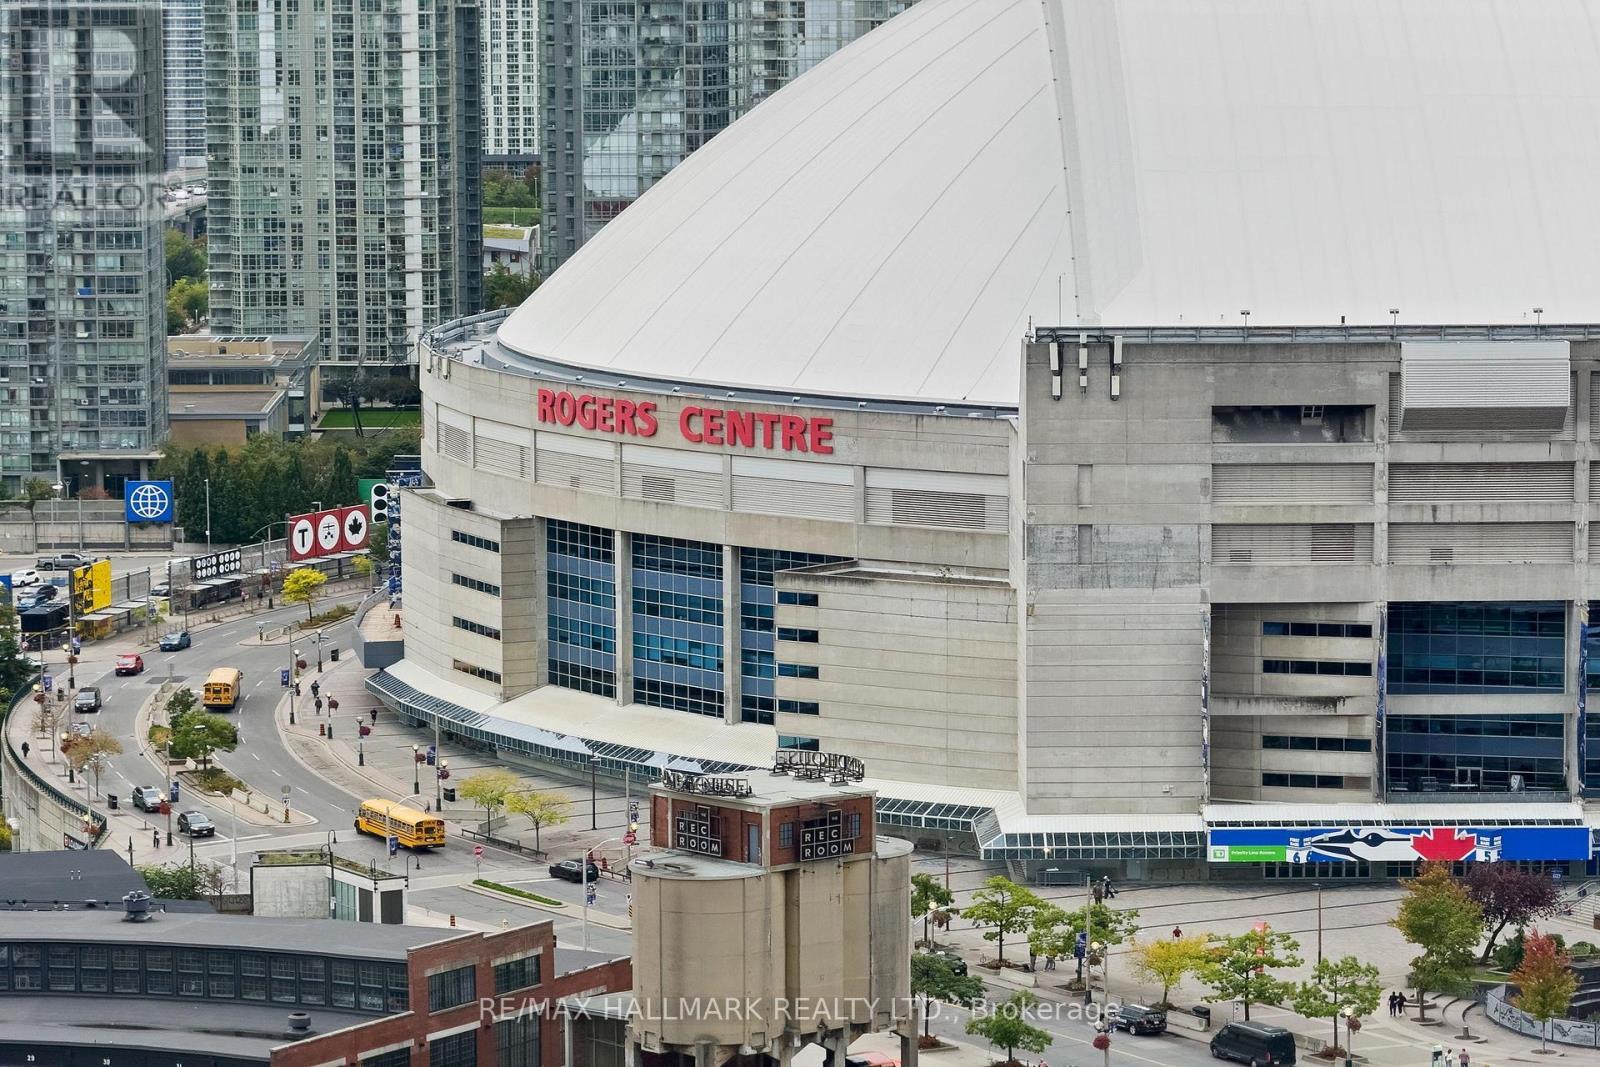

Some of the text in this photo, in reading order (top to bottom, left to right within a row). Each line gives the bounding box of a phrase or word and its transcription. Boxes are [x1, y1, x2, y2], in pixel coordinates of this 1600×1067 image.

[538, 388, 835, 455] ROGERS CENTRE
[679, 822, 707, 835] REC
[804, 829, 839, 842] REC
[679, 837, 719, 852] ROOM
[804, 843, 852, 857] ROOM
[1293, 852, 1301, 862] 6
[1484, 851, 1491, 861] 5
